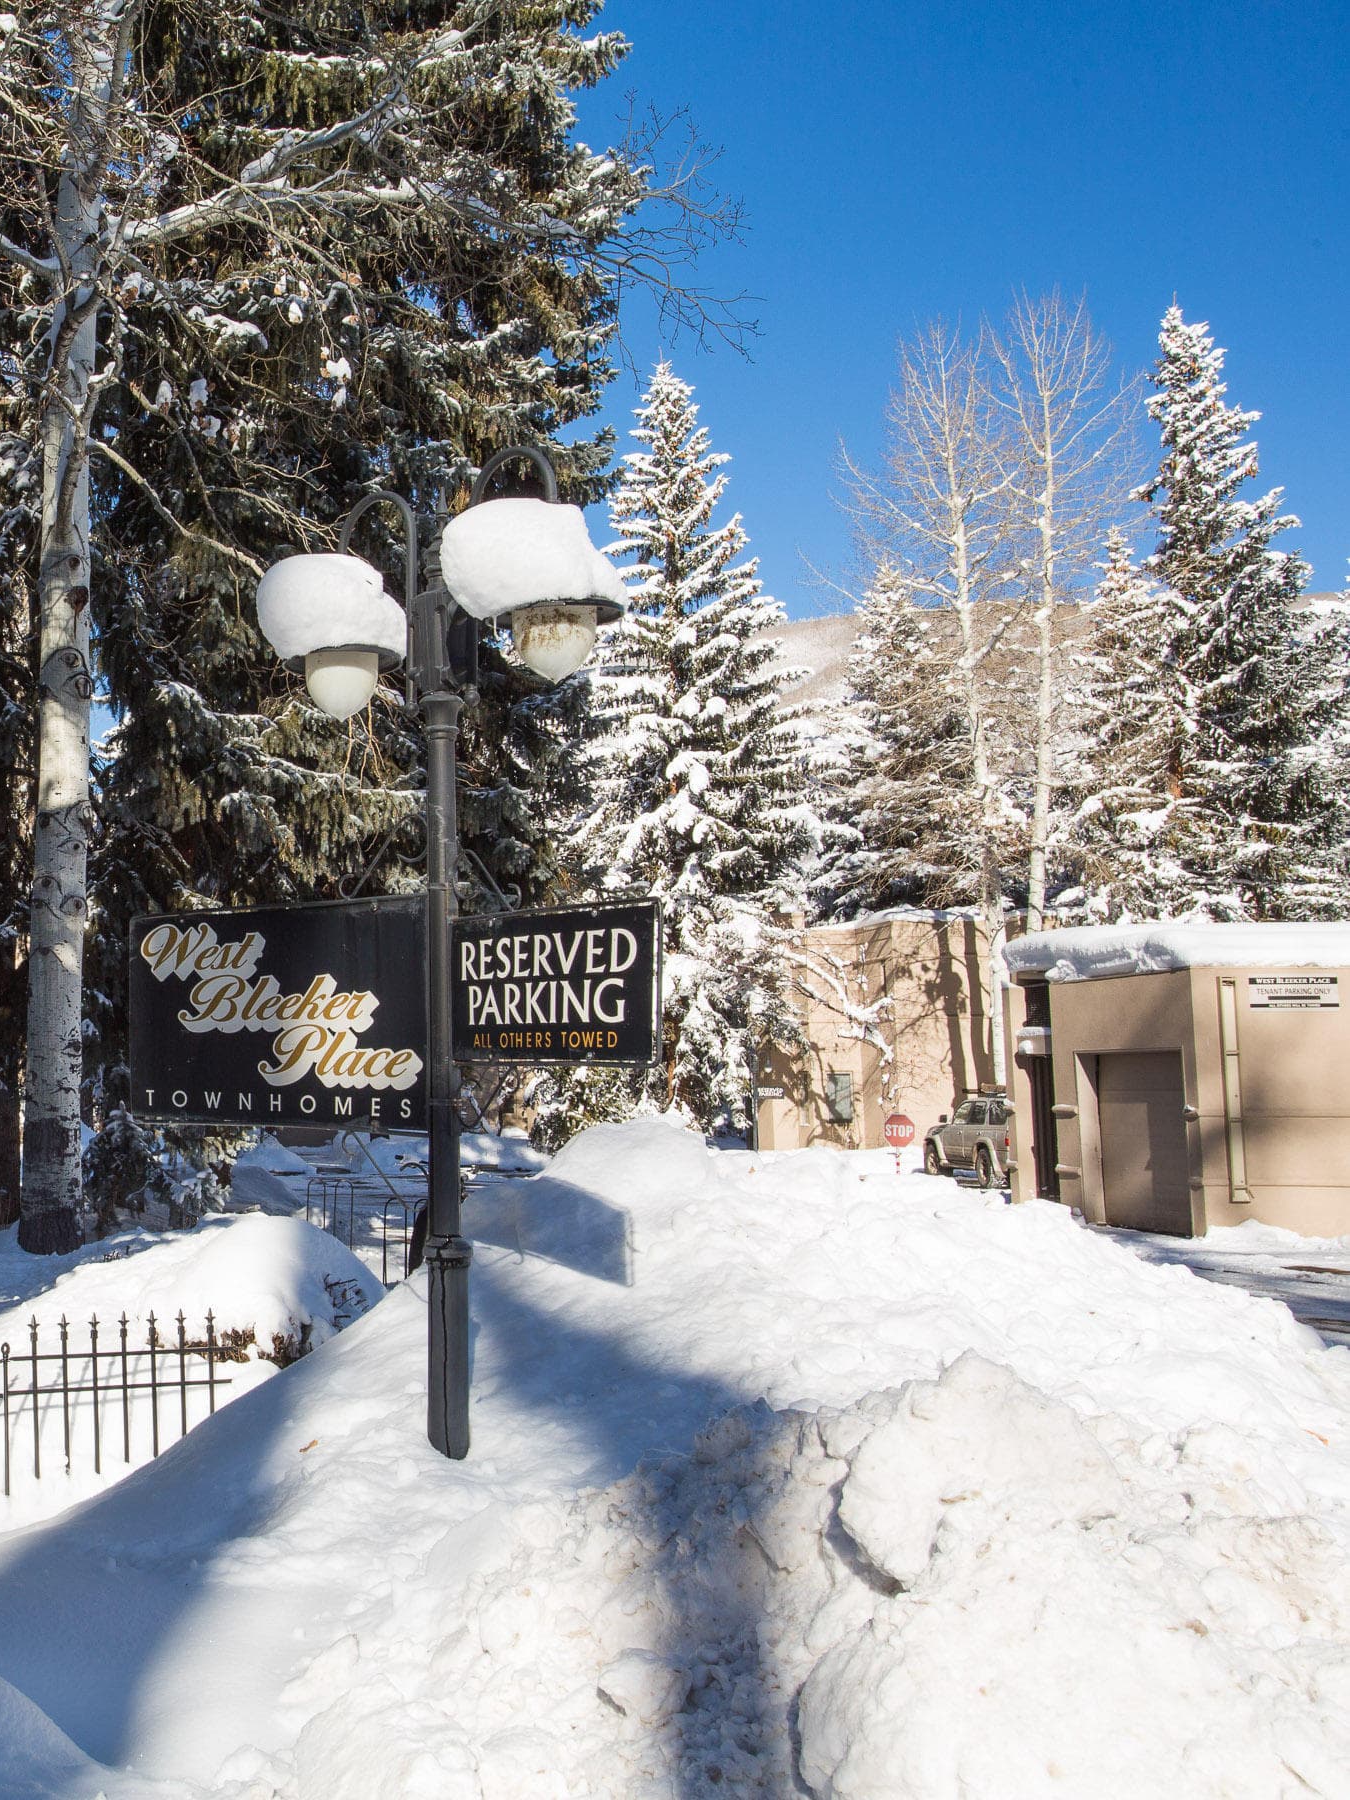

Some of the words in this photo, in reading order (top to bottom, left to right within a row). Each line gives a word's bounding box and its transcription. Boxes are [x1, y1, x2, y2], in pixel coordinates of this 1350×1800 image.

[141, 922, 266, 982] West
[461, 928, 638, 981] RESERVED
[177, 973, 380, 1034] Bleeker
[468, 978, 626, 1025] PARKING
[1309, 976, 1330, 984] PLACE
[257, 1024, 424, 1090] Place
[474, 1033, 492, 1048] ALL
[500, 1032, 551, 1048] OTHERS
[561, 1031, 618, 1048] TOWED
[145, 1089, 411, 1118] TOWNHOMES
[885, 1124, 914, 1138] STOP
